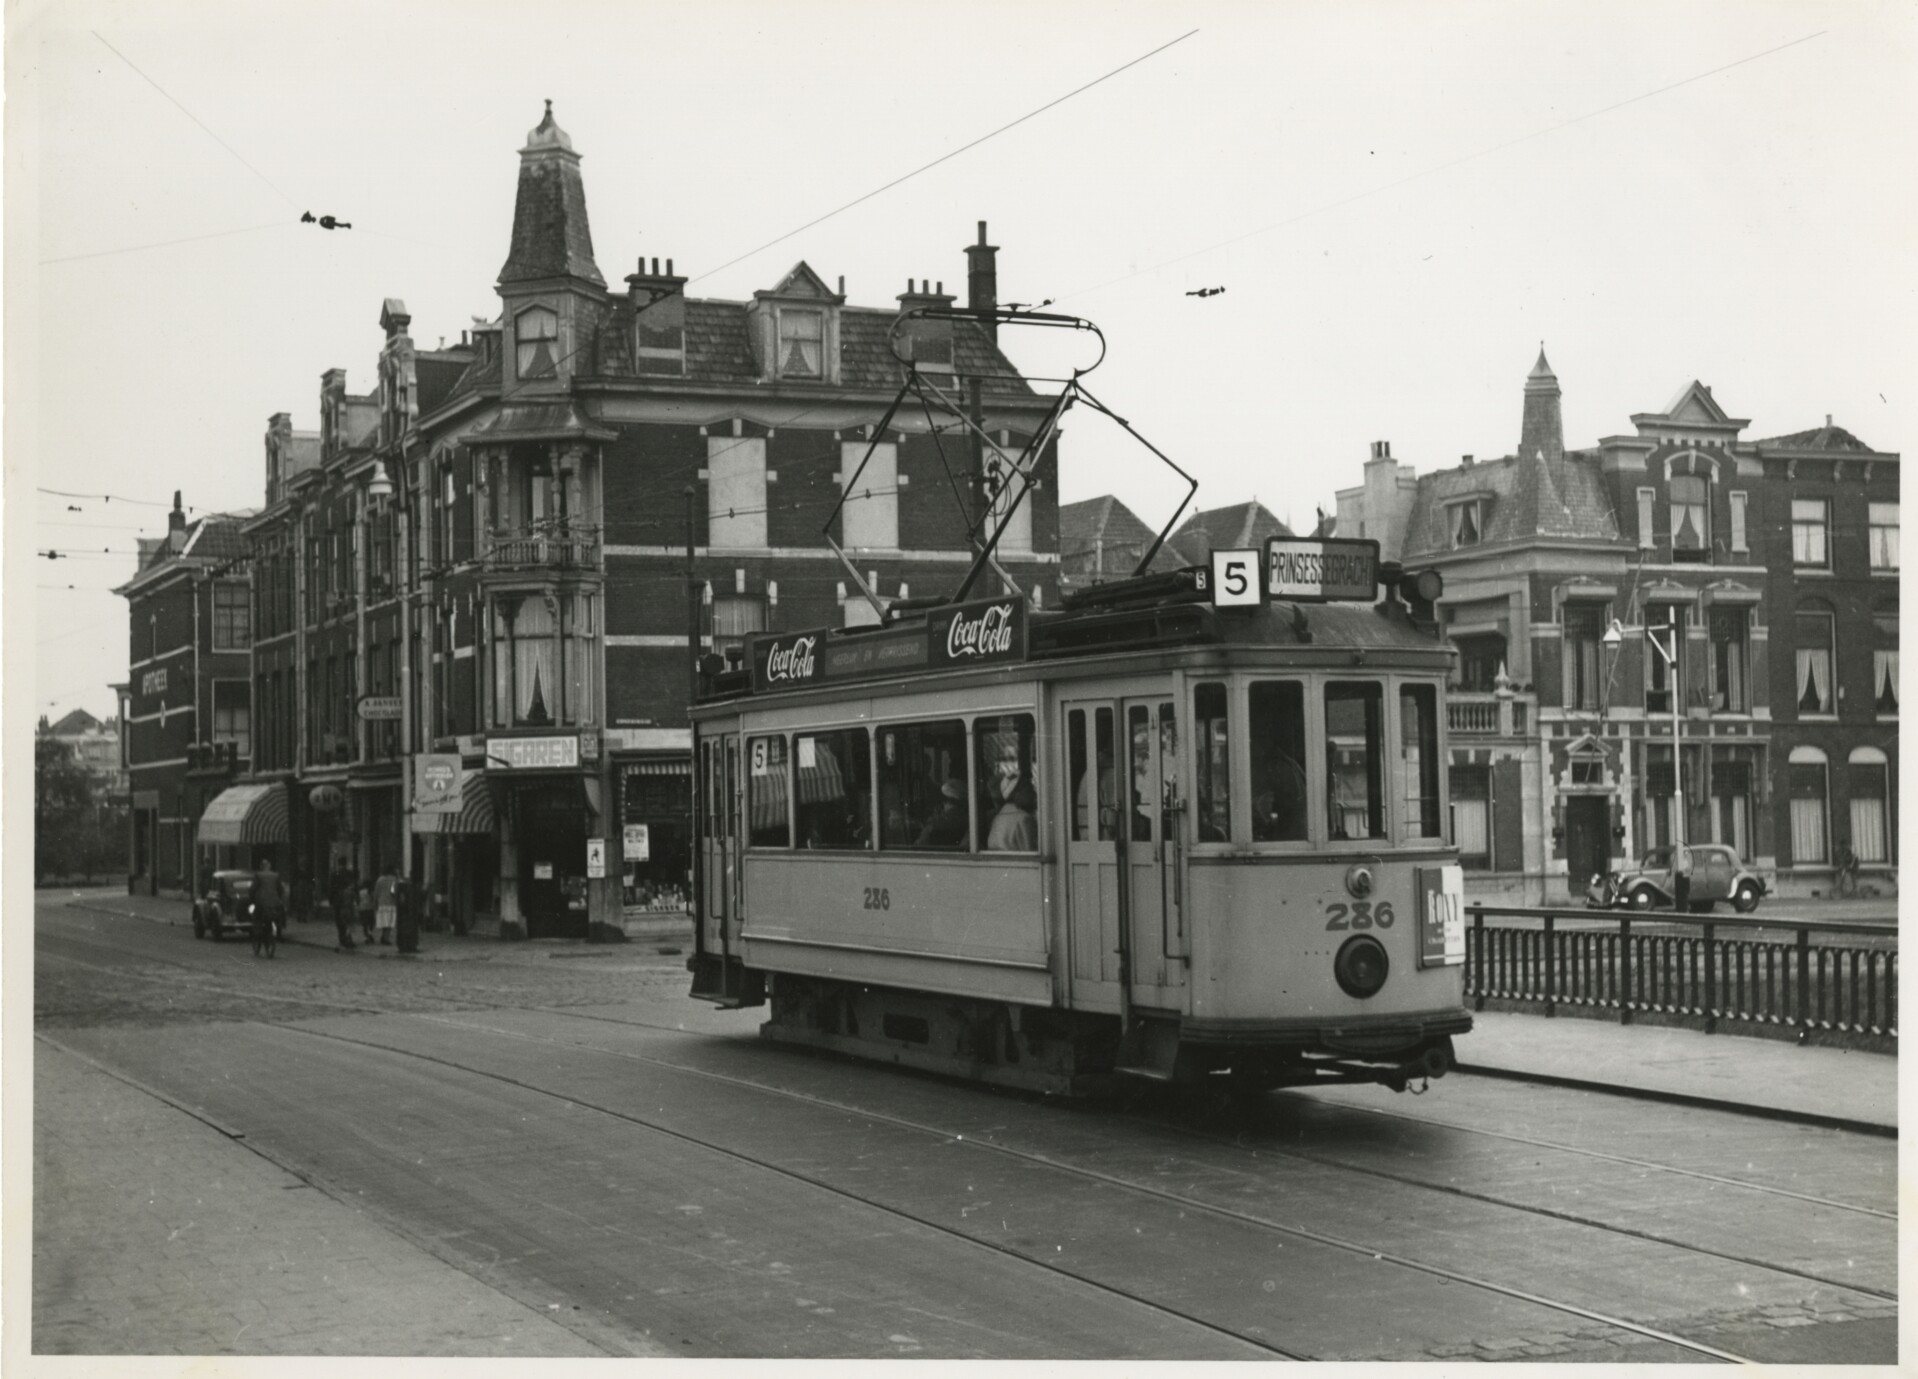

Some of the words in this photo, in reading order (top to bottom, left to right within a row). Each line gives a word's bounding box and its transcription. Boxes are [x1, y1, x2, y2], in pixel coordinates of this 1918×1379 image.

[1197, 571, 1206, 589] 5
[1224, 561, 1249, 596] 5
[1269, 551, 1375, 588] PRINSESSEGRACHT
[946, 603, 1014, 658] Coca-Cola
[766, 635, 817, 682] Coca-Cola
[490, 739, 575, 766] SIGAREN
[754, 743, 764, 769] 5
[863, 887, 890, 911] 286
[1325, 901, 1395, 931] 286
